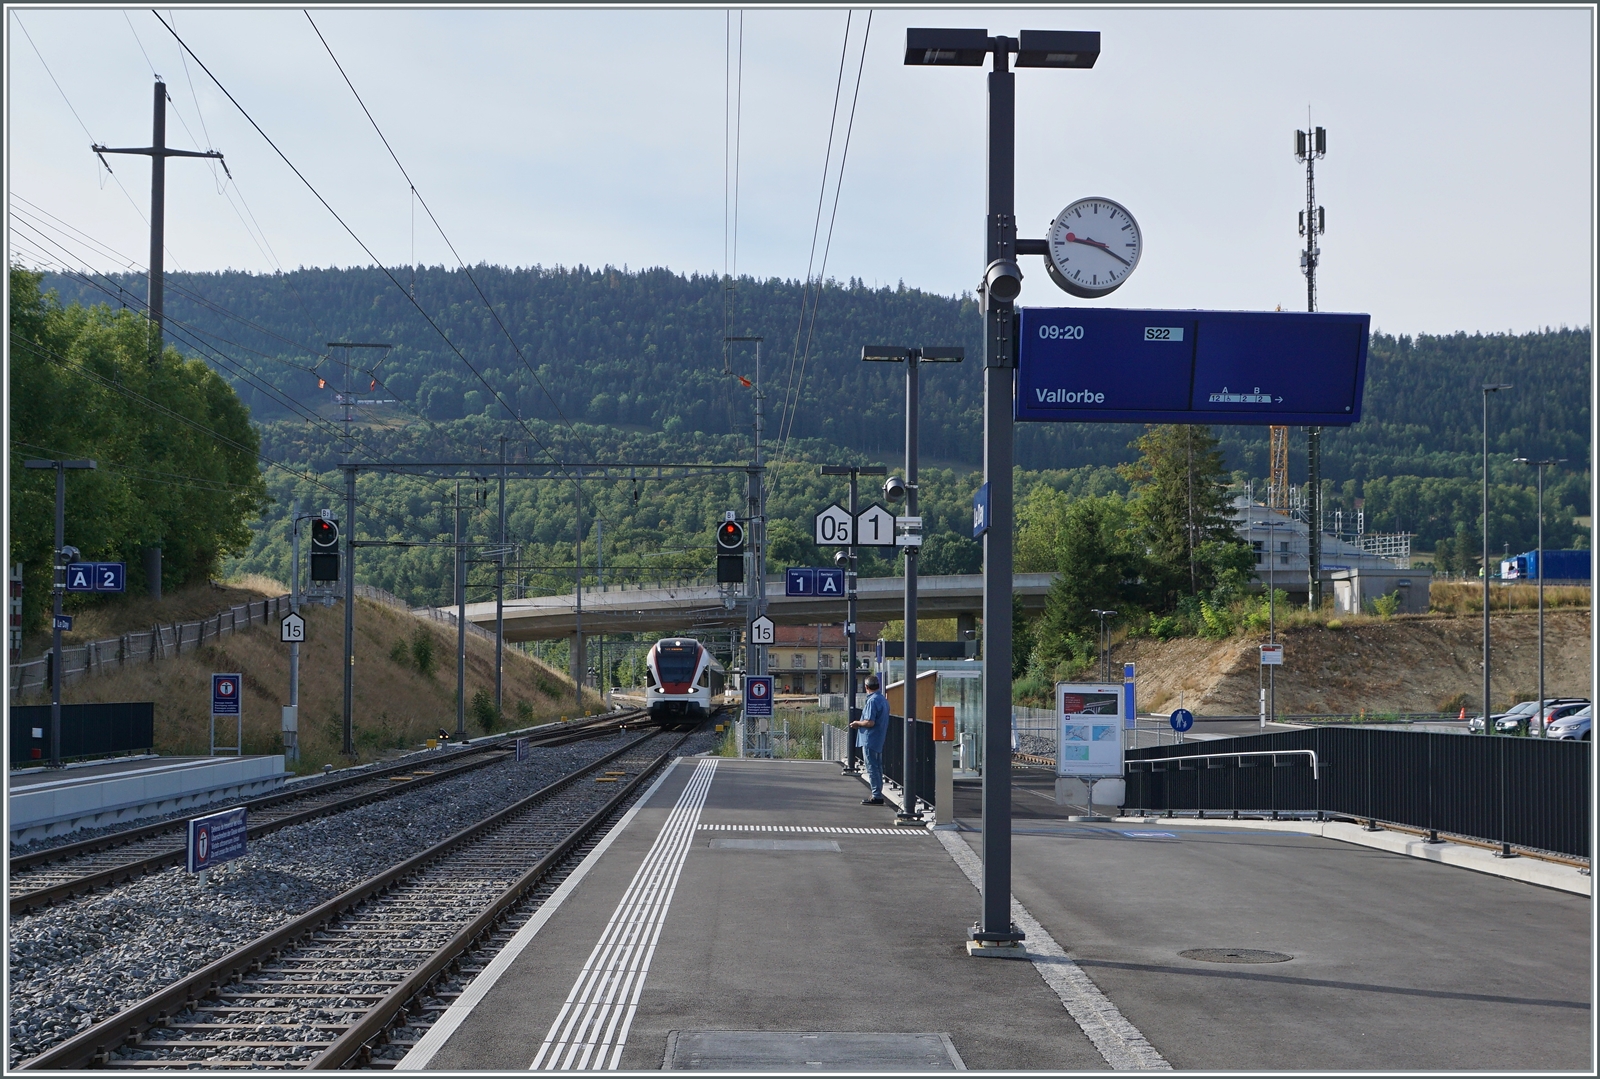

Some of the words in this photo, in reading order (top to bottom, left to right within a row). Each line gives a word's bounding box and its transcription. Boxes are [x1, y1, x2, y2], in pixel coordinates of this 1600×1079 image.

[1038, 325, 1084, 340] 09:20
[1146, 328, 1170, 340] S22
[1035, 388, 1105, 404] Vallorbe
[1222, 386, 1229, 394] A
[1253, 386, 1260, 394] B
[821, 515, 848, 541] 05
[868, 514, 879, 540] 1
[73, 571, 87, 587] A
[103, 571, 115, 587] 2
[796, 576, 804, 592] 1
[823, 577, 837, 592] A
[284, 621, 301, 638] 15
[754, 624, 771, 640] 15
